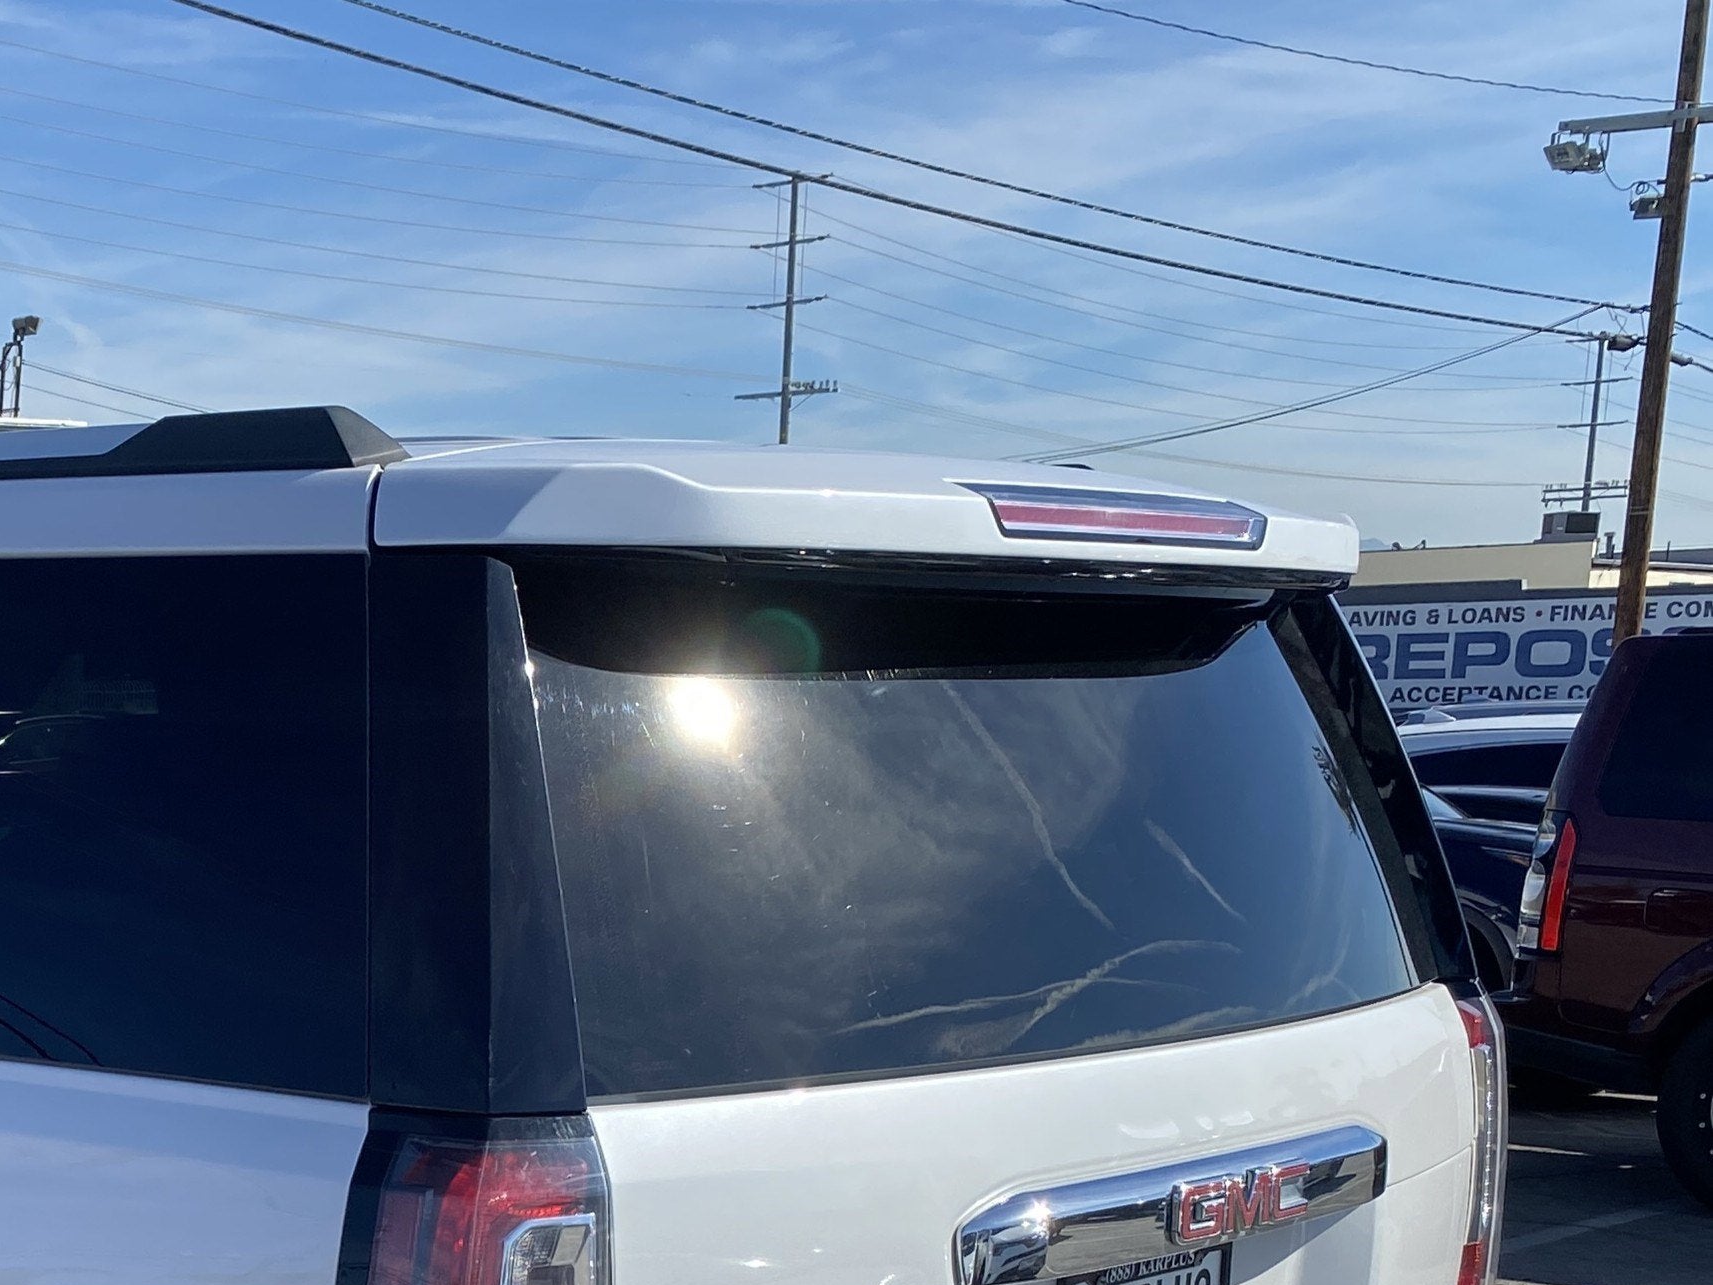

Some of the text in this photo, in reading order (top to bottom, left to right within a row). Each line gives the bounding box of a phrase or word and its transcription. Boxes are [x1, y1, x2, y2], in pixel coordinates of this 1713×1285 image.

[1344, 610, 1417, 627] AVING
[1426, 608, 1440, 626] &
[1448, 606, 1526, 625] LOANS
[1178, 1161, 1311, 1242] GMC
[1138, 1249, 1195, 1277] KARPLUS
